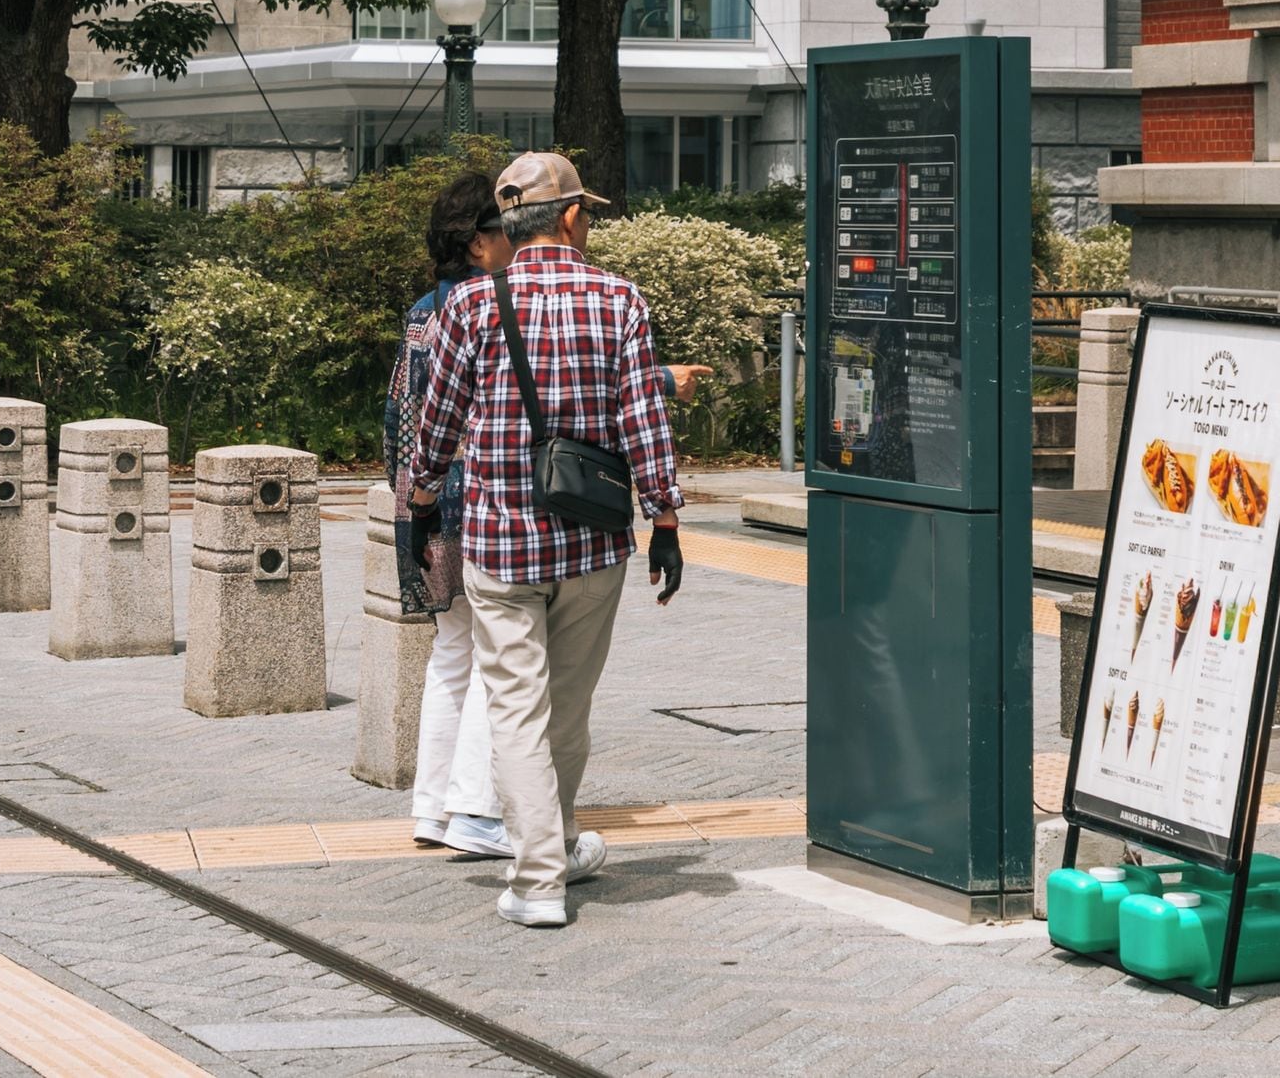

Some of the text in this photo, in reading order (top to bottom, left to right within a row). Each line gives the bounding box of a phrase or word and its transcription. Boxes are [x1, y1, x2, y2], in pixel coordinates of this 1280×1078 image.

[864, 72, 933, 100] 大阪市中央公会堂
[1204, 350, 1239, 377] NAKANOSHIMA
[1210, 379, 1226, 391] 中之島
[1166, 390, 1268, 423] ソーシャル イート アウェイク
[1194, 421, 1228, 438] TOGO MENU
[1128, 542, 1140, 553] SOFT
[1148, 546, 1166, 557] PARFAIT
[1219, 560, 1235, 571] DRINK
[1108, 667, 1120, 678] SOFT
